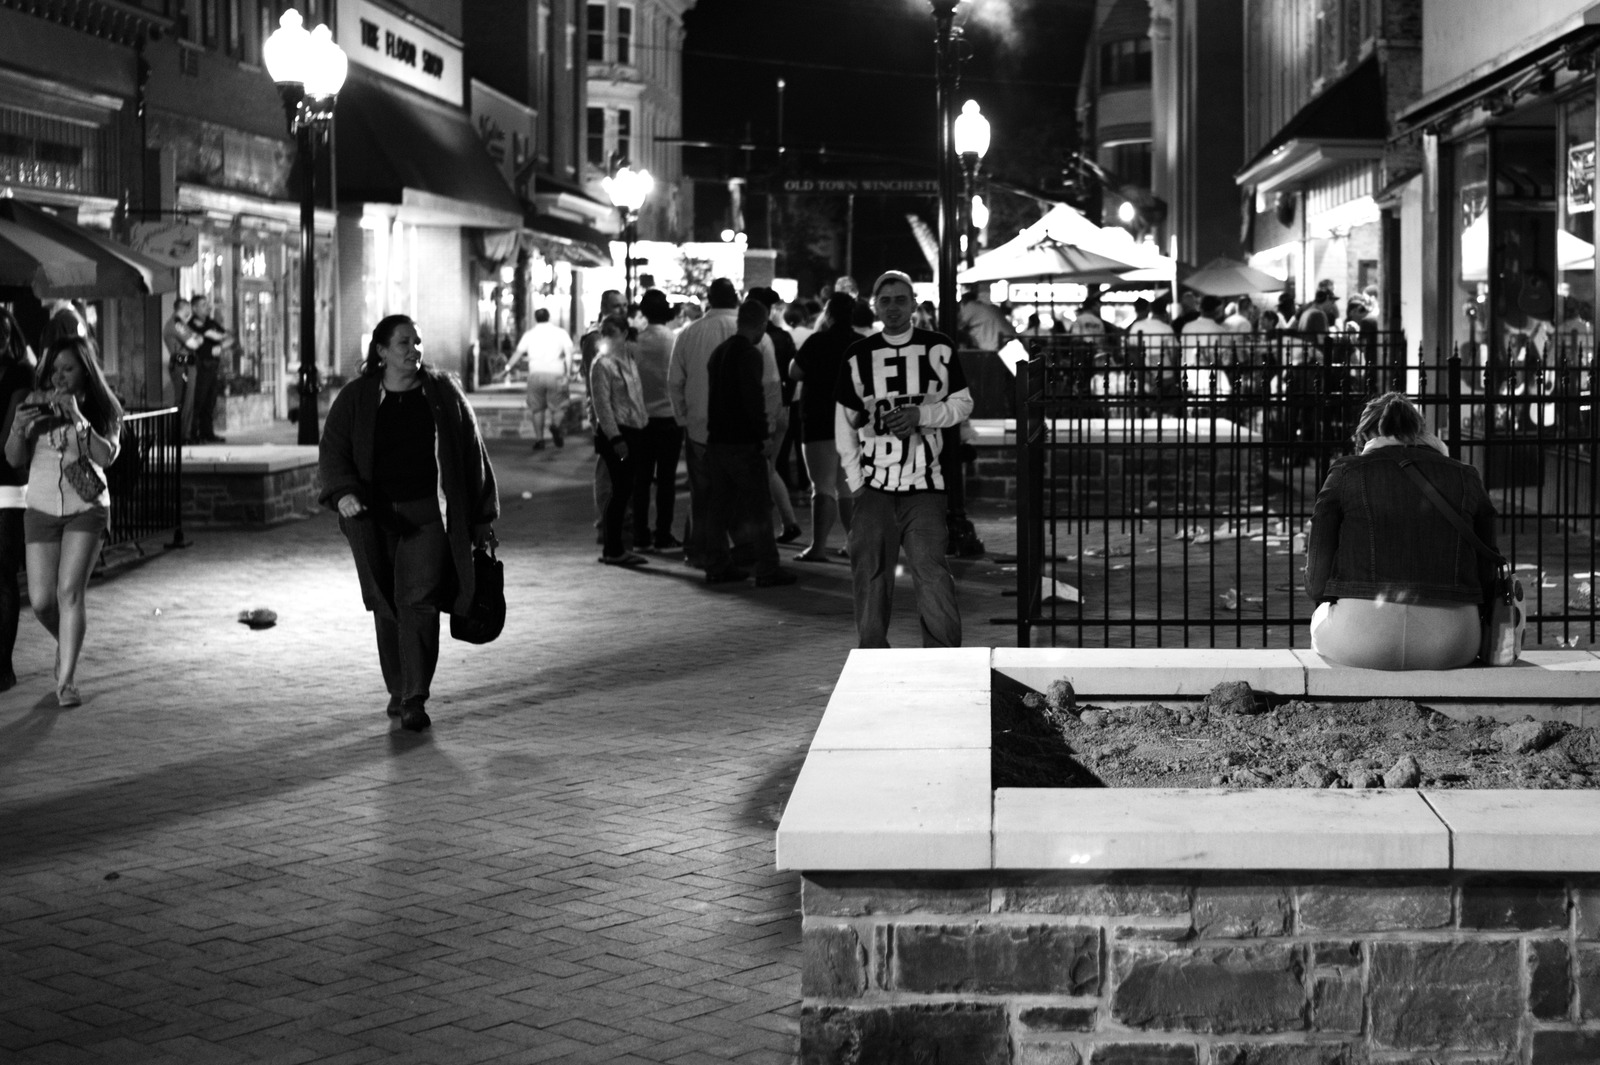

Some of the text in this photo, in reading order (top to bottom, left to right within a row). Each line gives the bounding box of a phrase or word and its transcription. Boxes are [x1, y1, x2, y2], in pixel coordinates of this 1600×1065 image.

[360, 17, 379, 51] THE
[386, 29, 416, 68] FLOOR
[784, 180, 939, 191] OLD TOWN WINCHESTE
[848, 344, 952, 404] LETS
